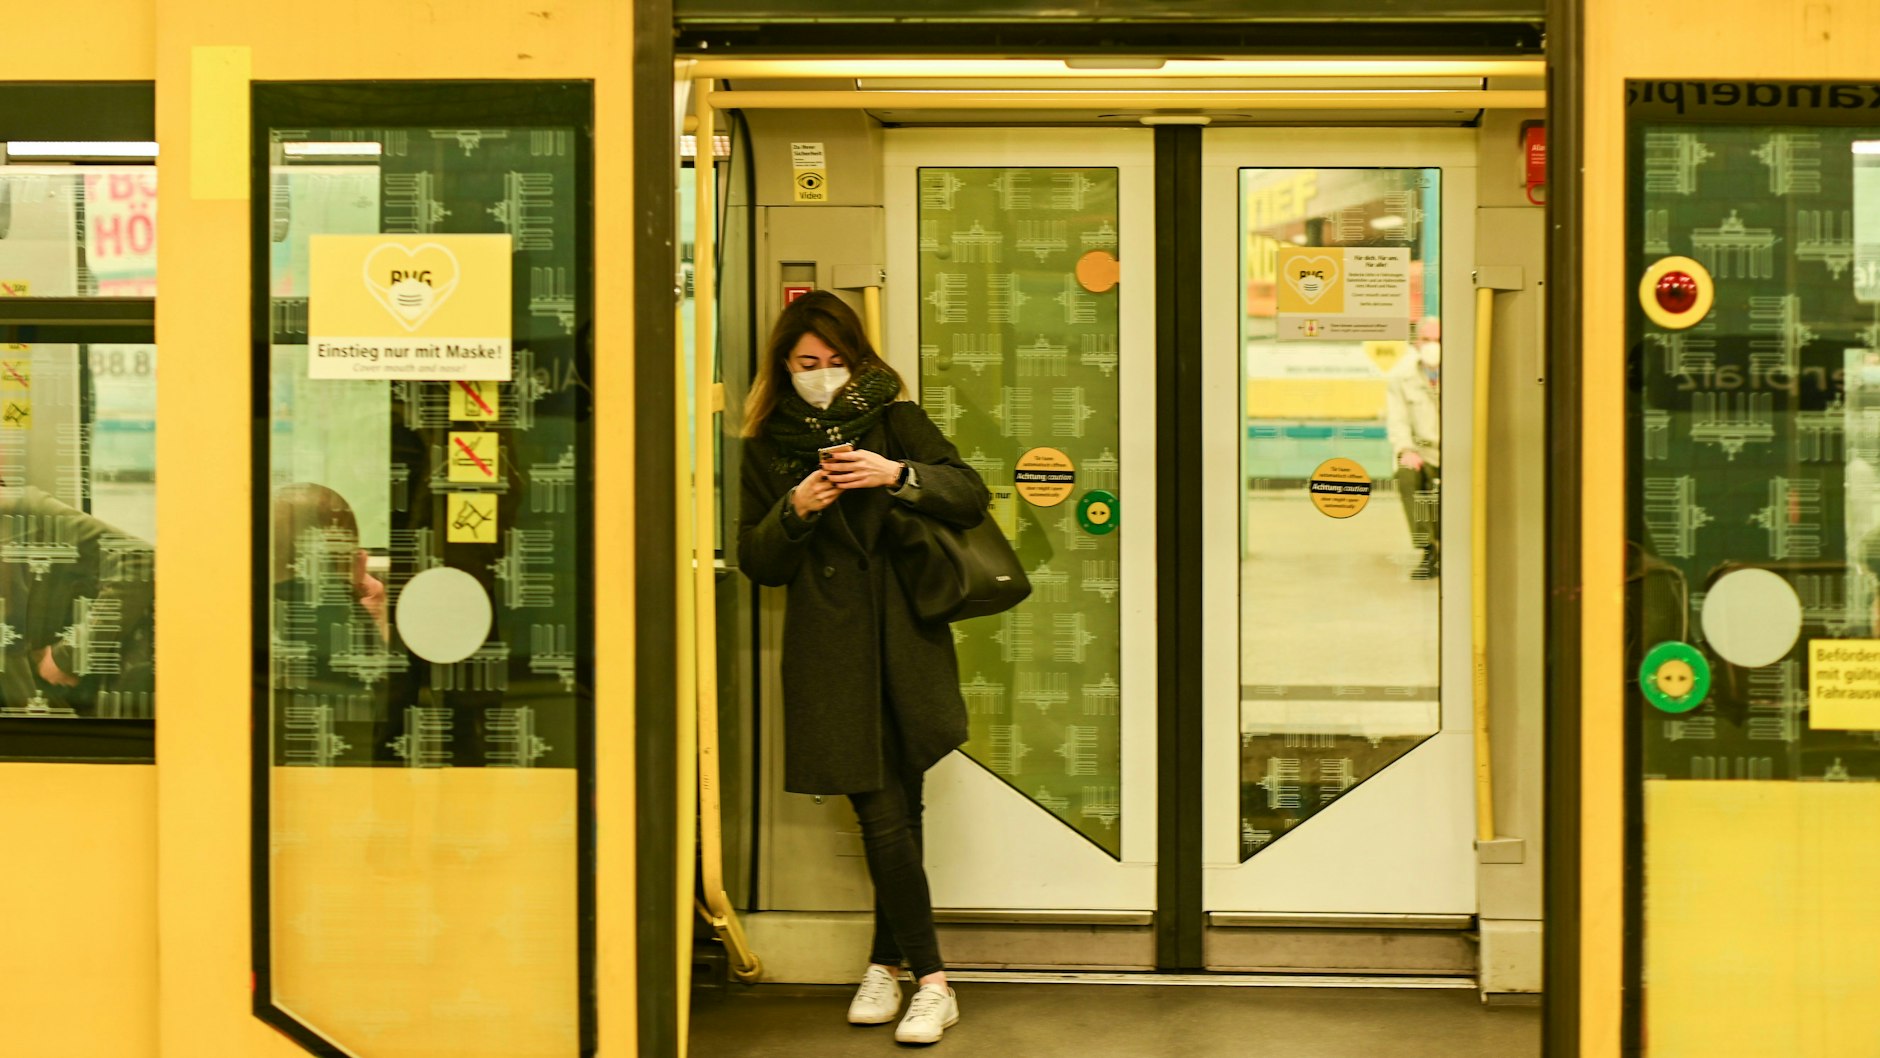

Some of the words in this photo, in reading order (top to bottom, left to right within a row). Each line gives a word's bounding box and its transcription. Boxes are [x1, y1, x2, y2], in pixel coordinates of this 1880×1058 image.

[799, 191, 822, 200] Video
[318, 343, 379, 361] Einstieg
[384, 347, 410, 358] nur
[415, 344, 441, 358] mit
[447, 344, 502, 359] Maske!
[353, 363, 380, 373] Cover
[384, 363, 415, 373] mouth
[418, 363, 438, 373] and
[1016, 473, 1047, 481] Achtung
[1312, 483, 1343, 493] Achtung
[1816, 668, 1840, 680] mit
